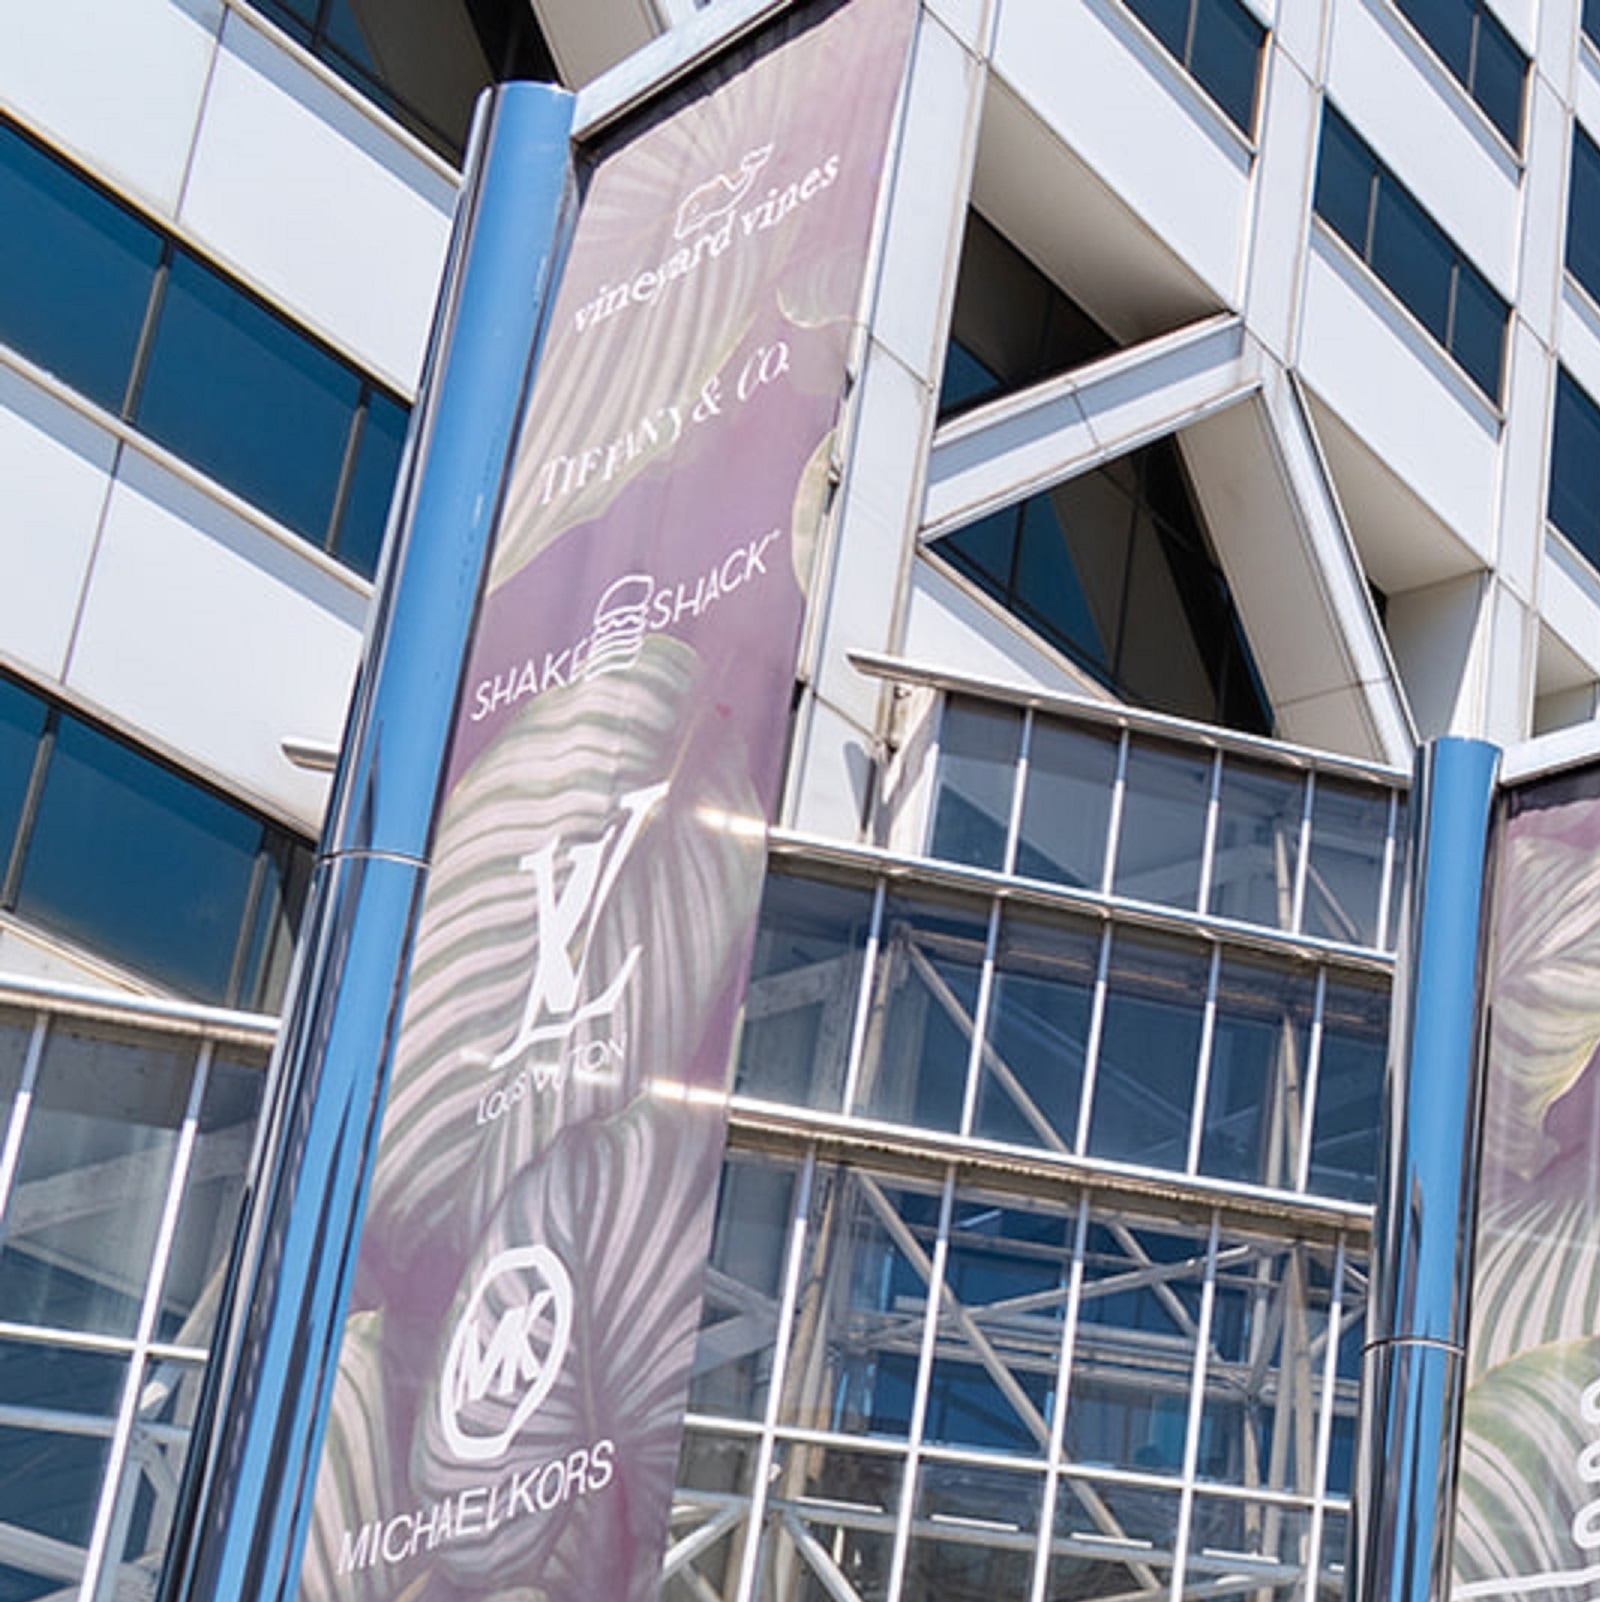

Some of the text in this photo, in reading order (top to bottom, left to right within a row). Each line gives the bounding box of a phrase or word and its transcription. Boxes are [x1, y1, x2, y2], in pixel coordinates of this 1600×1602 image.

[736, 155, 840, 243] vines
[692, 376, 723, 423] &
[470, 541, 771, 721] SHAKE SHACK
[338, 1439, 615, 1576] MICHAEL KORS
